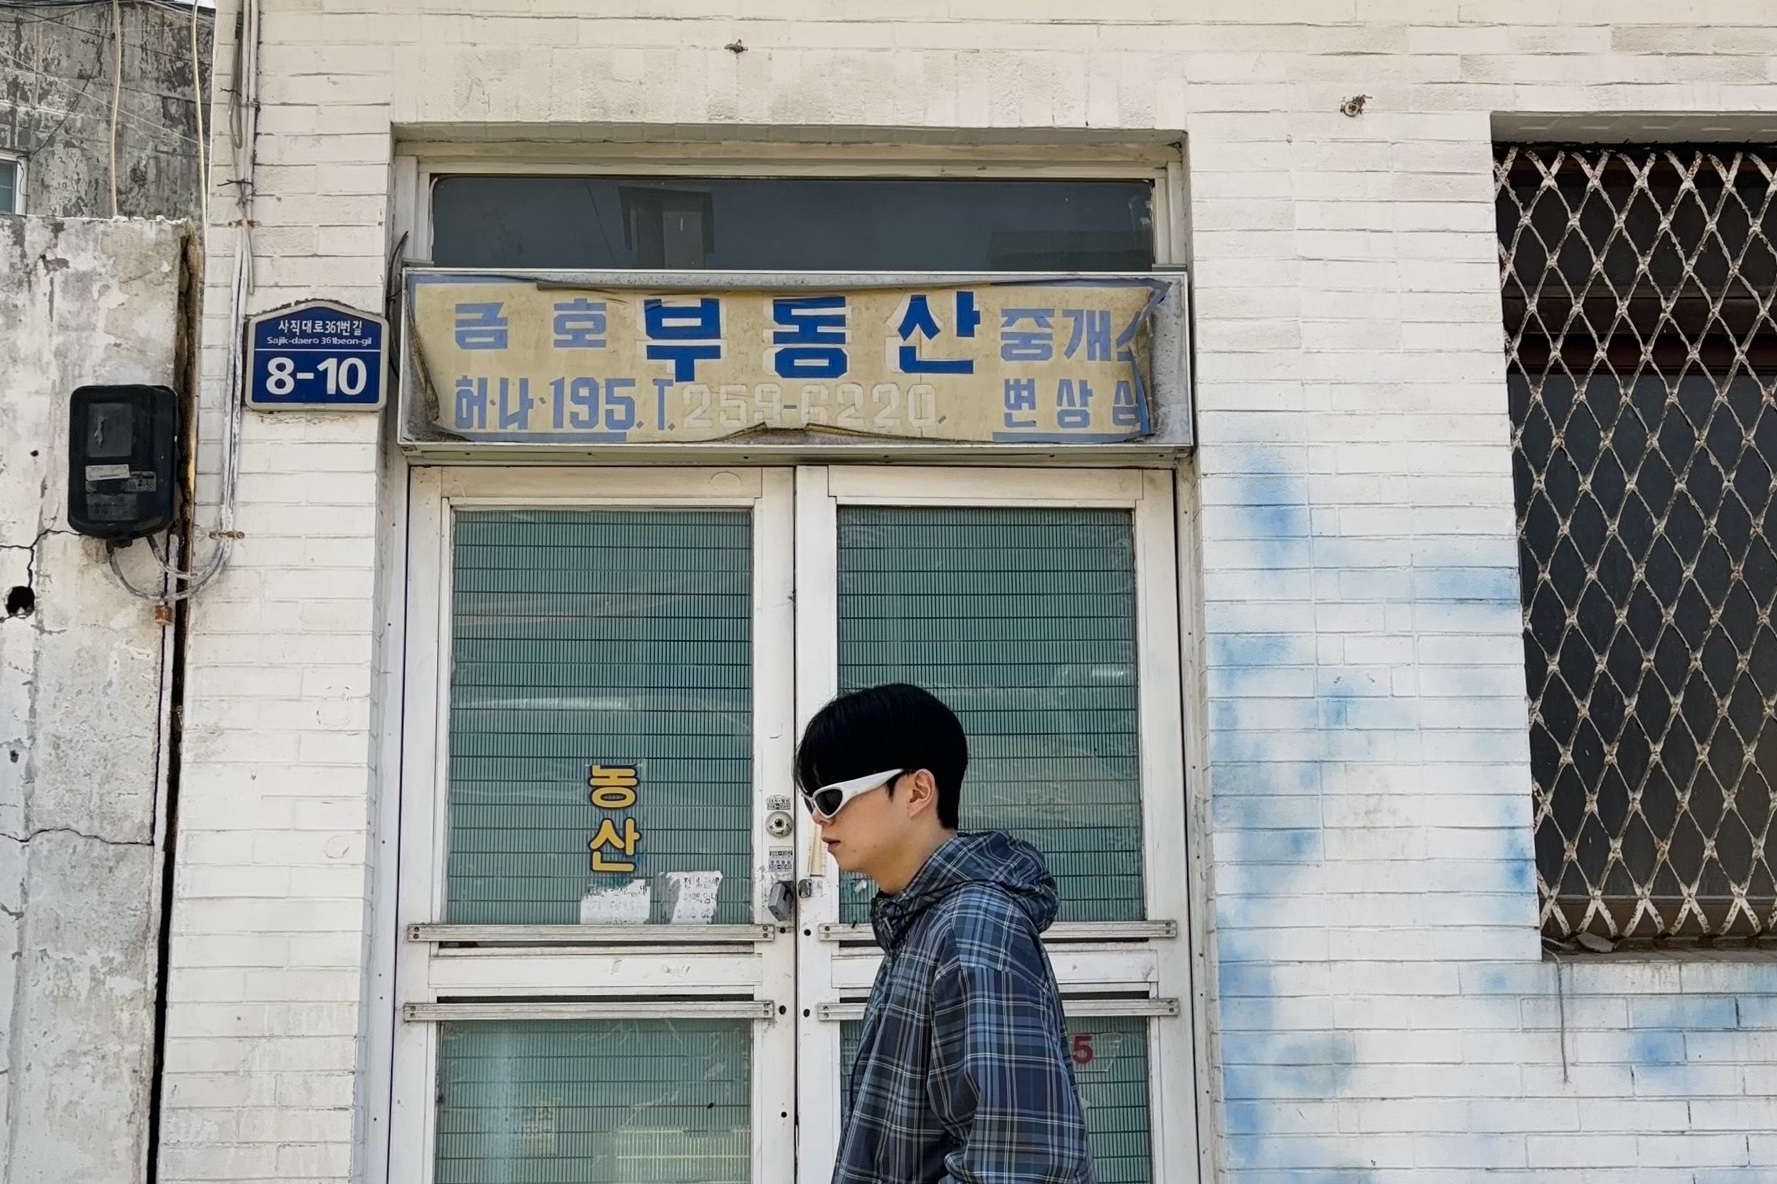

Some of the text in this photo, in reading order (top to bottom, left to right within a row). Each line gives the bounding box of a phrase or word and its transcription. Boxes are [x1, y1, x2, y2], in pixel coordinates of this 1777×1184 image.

[267, 336, 372, 347] Sajik-daero 361beon-gil
[278, 320, 362, 335] 사직대로361번길
[644, 291, 980, 382] 부동산
[266, 357, 367, 395] 8-10
[1073, 1035, 1094, 1064] 5
